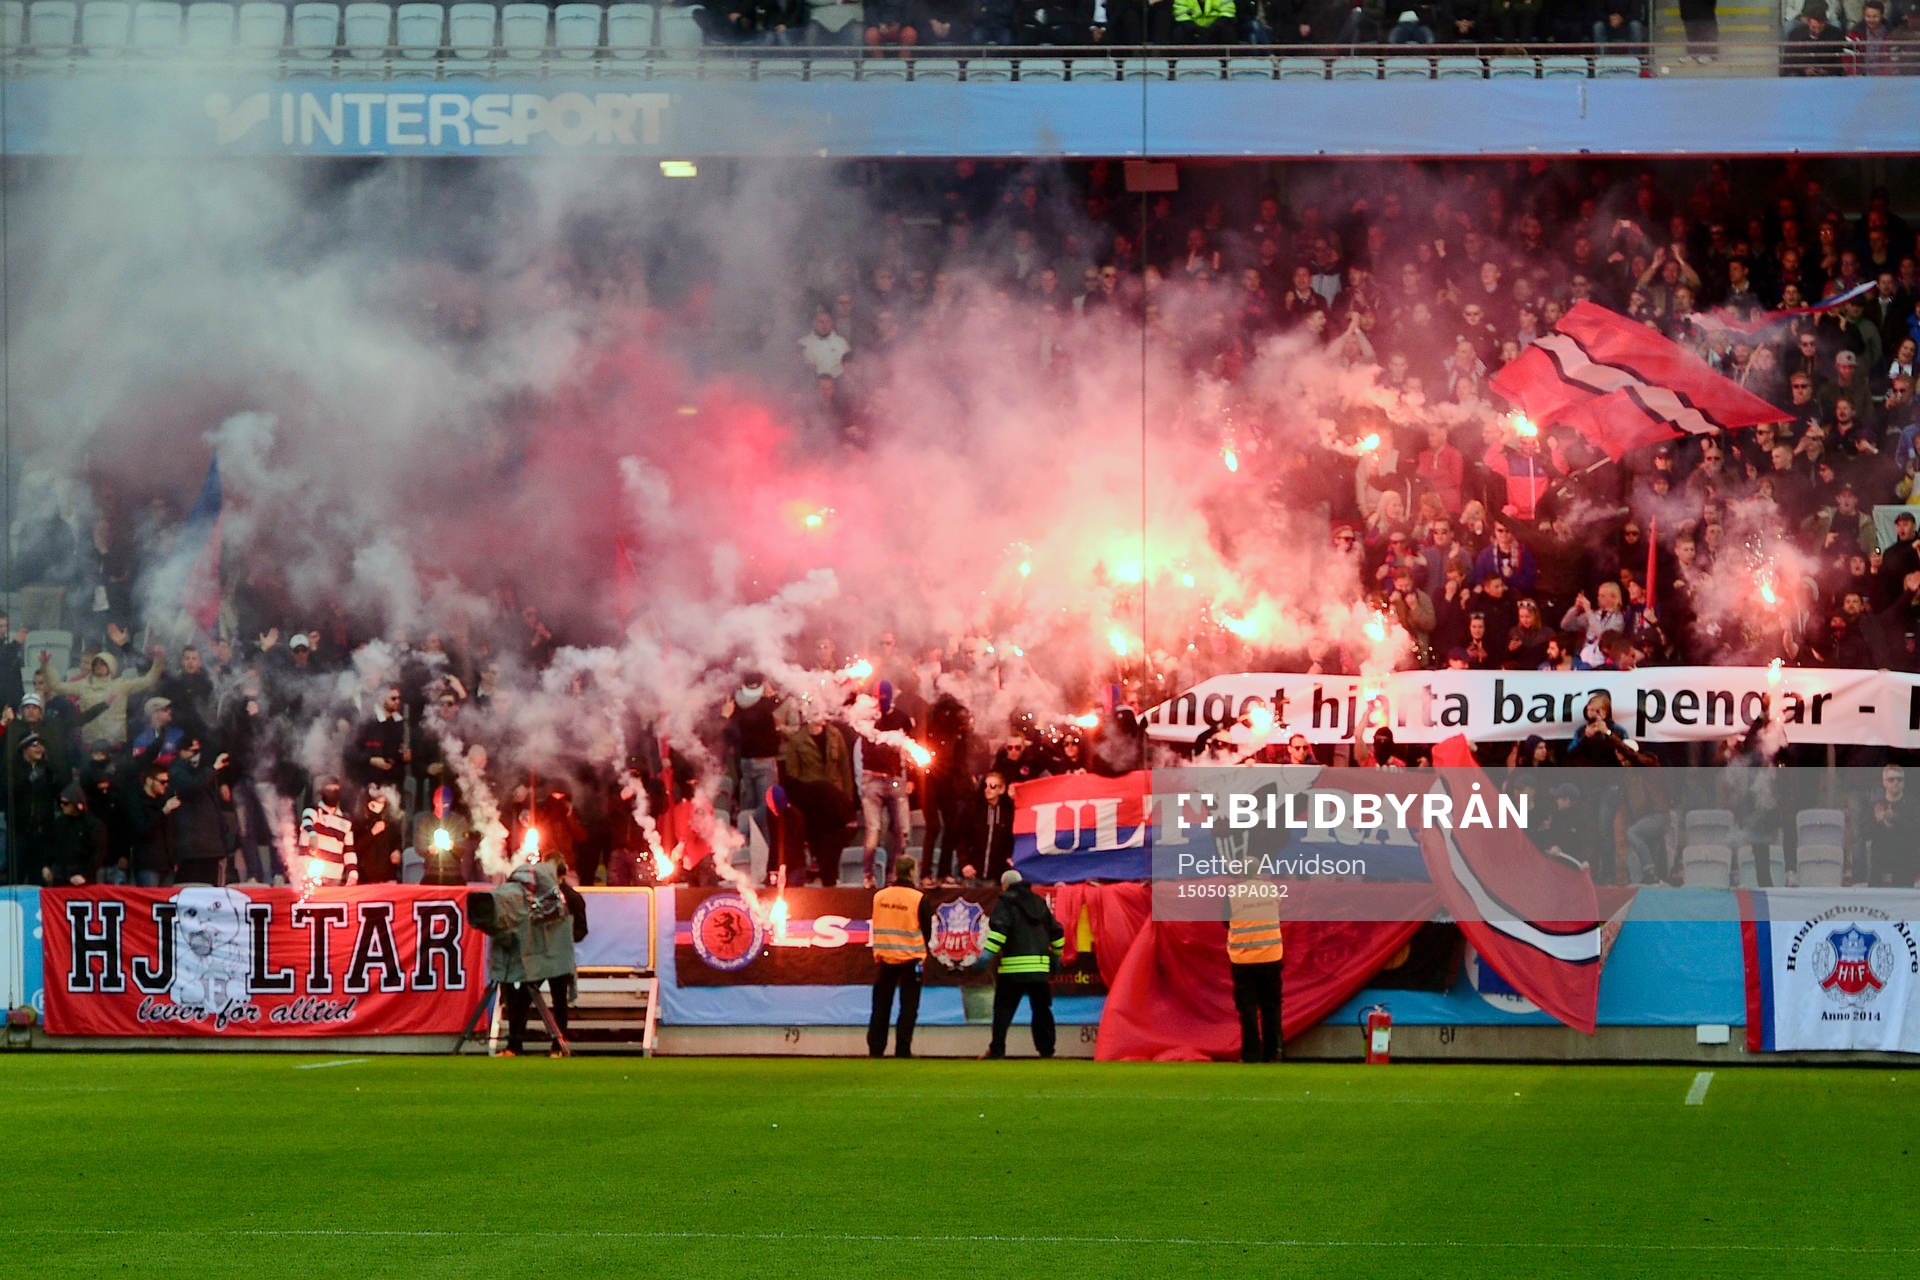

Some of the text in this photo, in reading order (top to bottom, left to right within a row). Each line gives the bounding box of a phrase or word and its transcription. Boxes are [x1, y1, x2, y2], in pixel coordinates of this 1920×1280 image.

[281, 92, 671, 146] INTERSPORT
[1893, 918, 1919, 974] Äldre
[137, 996, 357, 1031] lever för alltid
[1821, 1010, 1881, 1022] Anno 2014
[784, 1027, 800, 1044] 79
